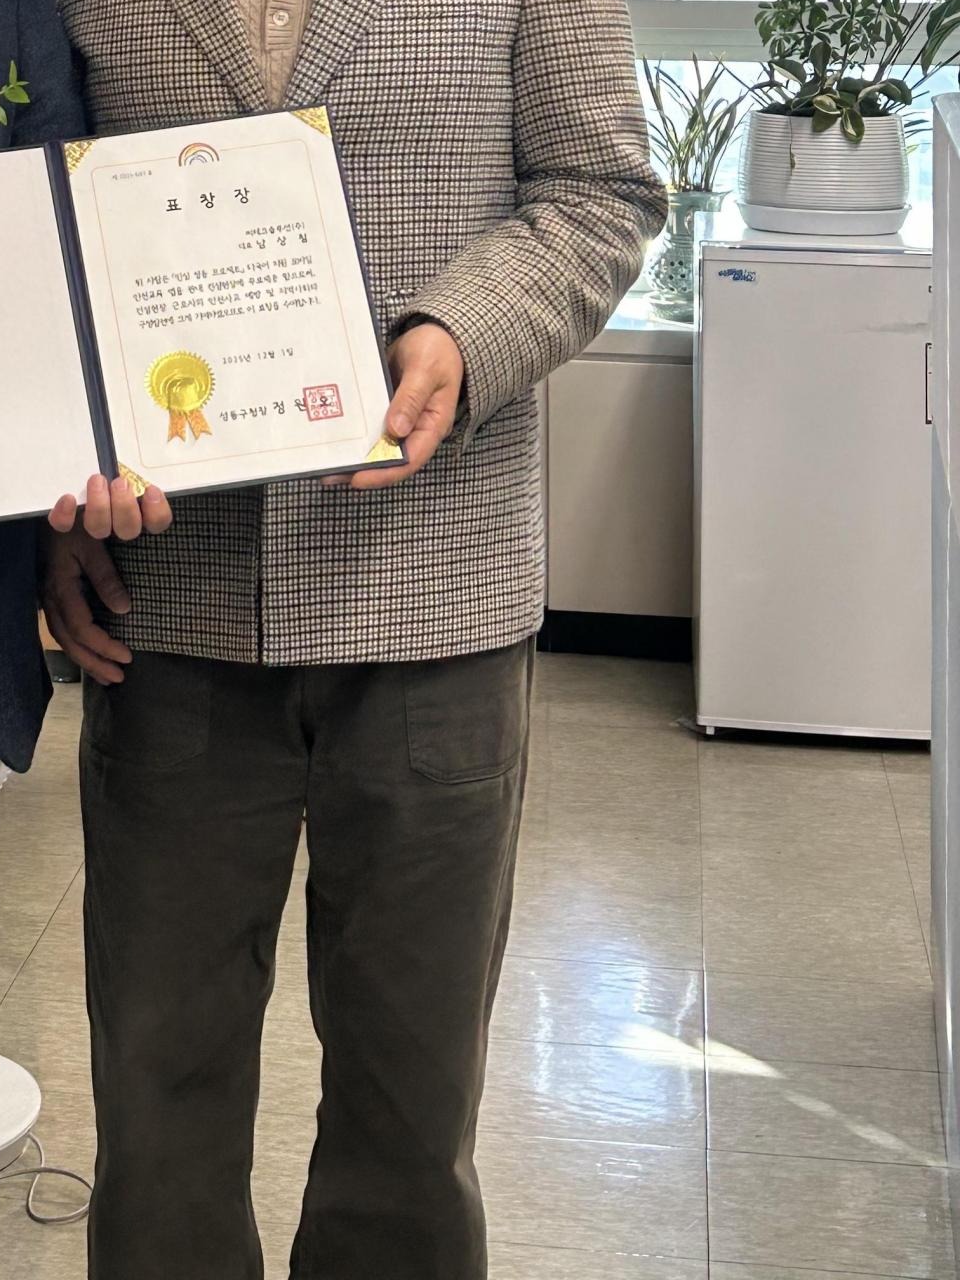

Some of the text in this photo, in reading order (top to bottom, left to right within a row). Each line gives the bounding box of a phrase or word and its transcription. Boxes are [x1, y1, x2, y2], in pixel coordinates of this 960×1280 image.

[166, 187, 250, 212] 표 창 장
[136, 304, 166, 315] 건설현장
[208, 294, 240, 305] 안전사고
[266, 288, 274, 297] 및
[220, 406, 267, 421] 성동구청장
